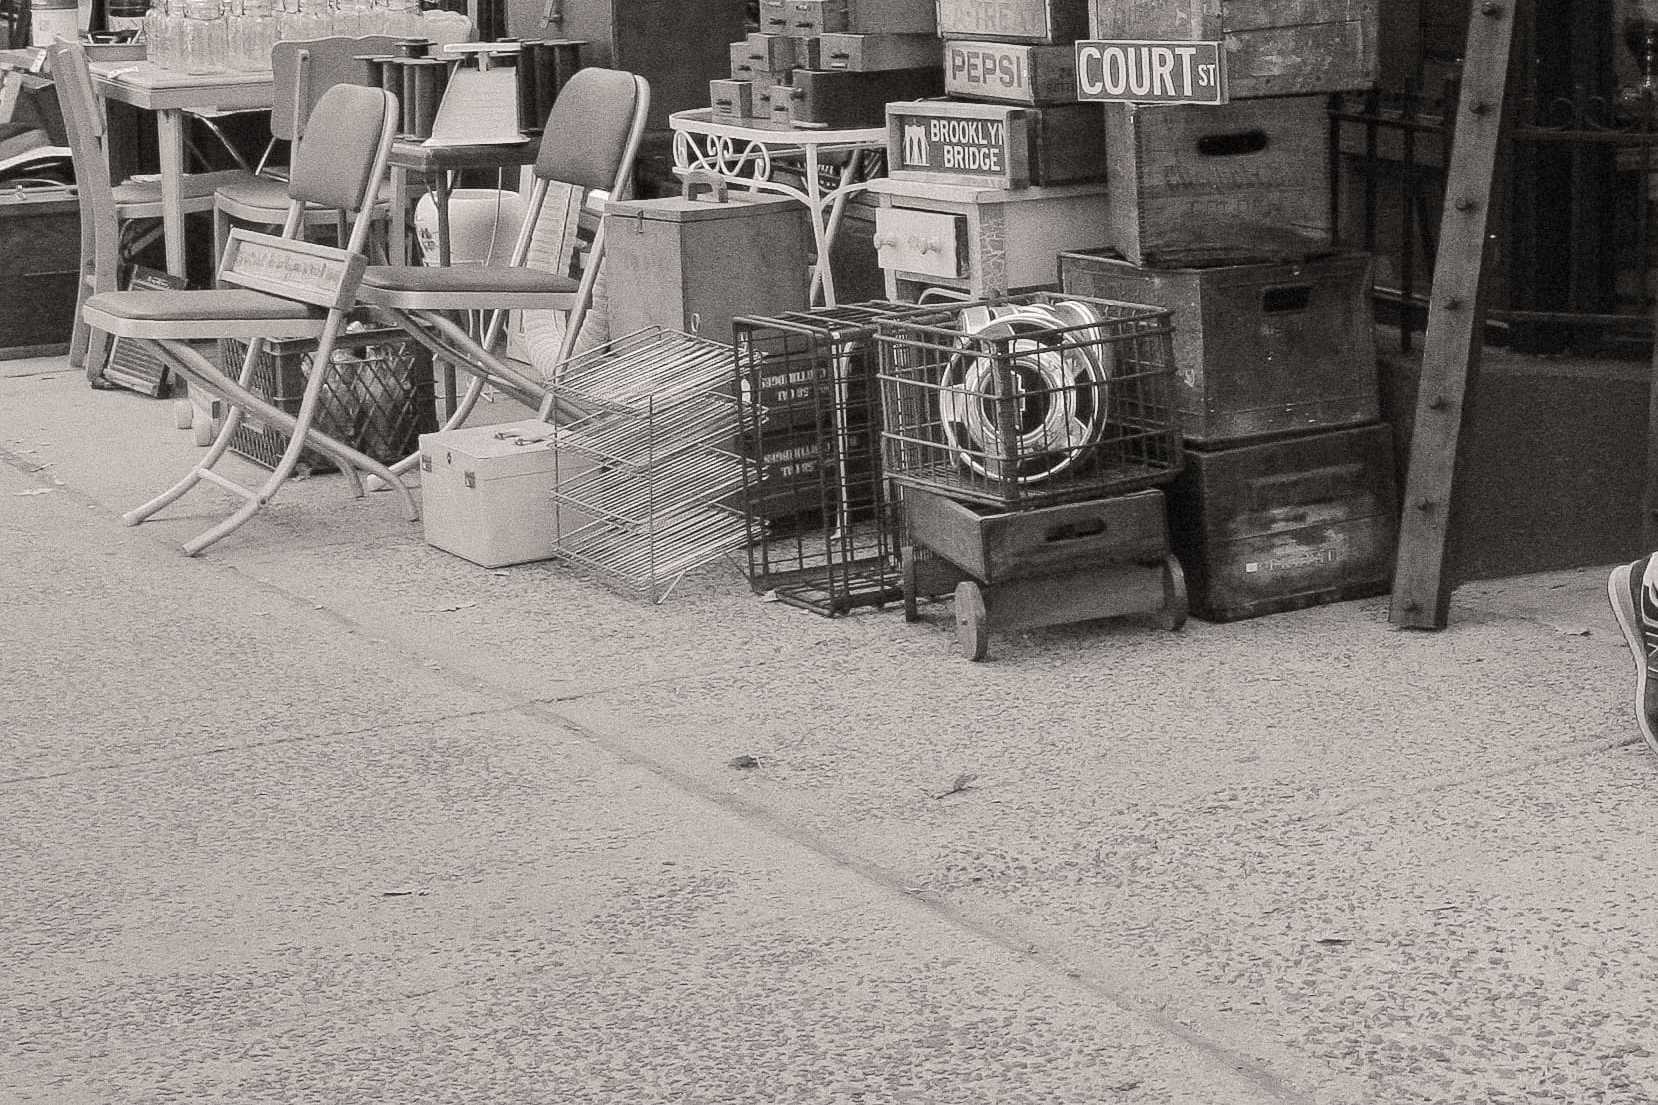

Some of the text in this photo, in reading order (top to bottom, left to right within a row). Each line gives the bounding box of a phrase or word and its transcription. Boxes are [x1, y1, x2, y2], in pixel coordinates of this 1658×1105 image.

[951, 50, 1023, 89] PEPSI
[1078, 46, 1197, 96] COURT
[1198, 64, 1217, 88] ST
[930, 118, 1005, 146] BROOKLYN
[943, 143, 1001, 172] BRIDGE
